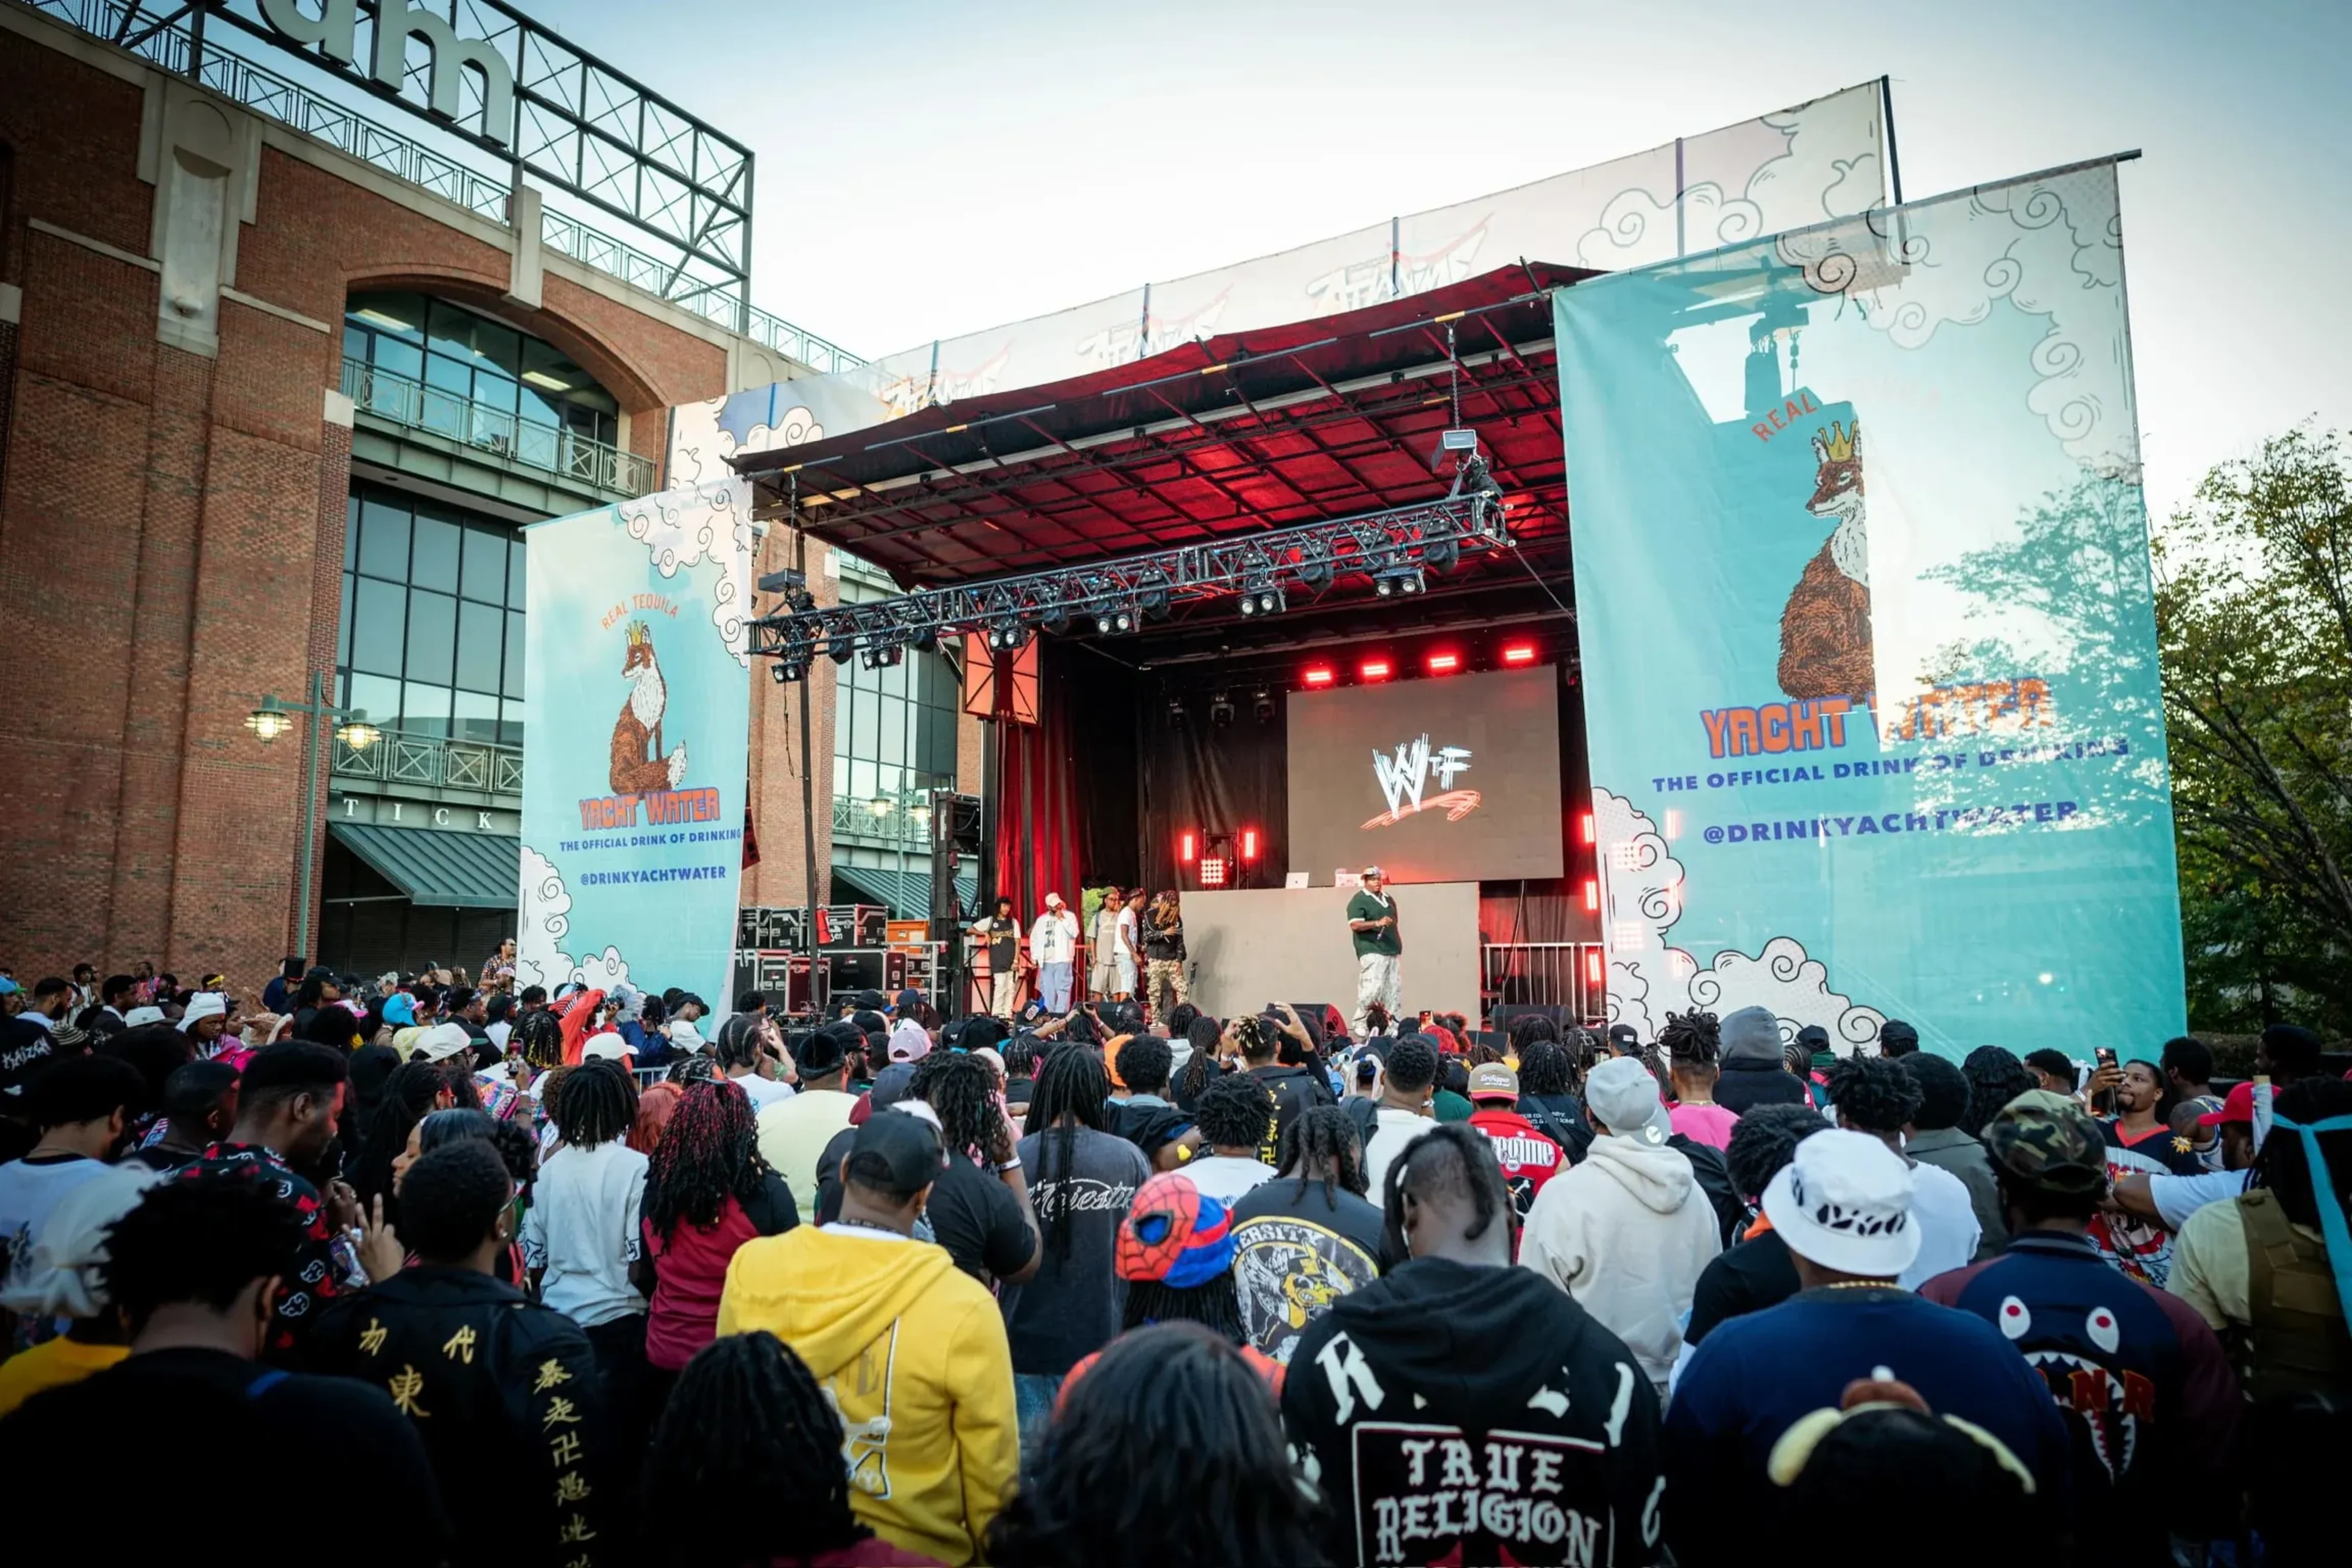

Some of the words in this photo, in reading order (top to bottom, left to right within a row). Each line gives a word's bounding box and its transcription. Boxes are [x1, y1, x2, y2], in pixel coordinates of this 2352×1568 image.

[1752, 393, 1818, 442] REAL
[601, 600, 629, 630] REAL
[631, 593, 679, 619] TEQUILA
[1700, 694, 1852, 759] YACHT
[1652, 775, 1698, 793] THE
[1706, 765, 1825, 788] OFFICIAL
[1833, 756, 1921, 779] DRINK
[1930, 753, 1968, 771] OF
[343, 797, 522, 834] TICK
[579, 795, 639, 831] YACHT
[644, 786, 721, 826] WATER
[559, 840, 579, 852] THE
[582, 837, 628, 850] OFFICIAL
[631, 834, 666, 846] DRINK
[669, 832, 686, 844] OF
[689, 827, 741, 843] DRINKING
[580, 865, 726, 886] @DRINKYACHTWATER
[1236, 1223, 1325, 1251] ERSITY
[1400, 1438, 1564, 1494] TRUE
[1373, 1488, 1602, 1568] RELIGION
